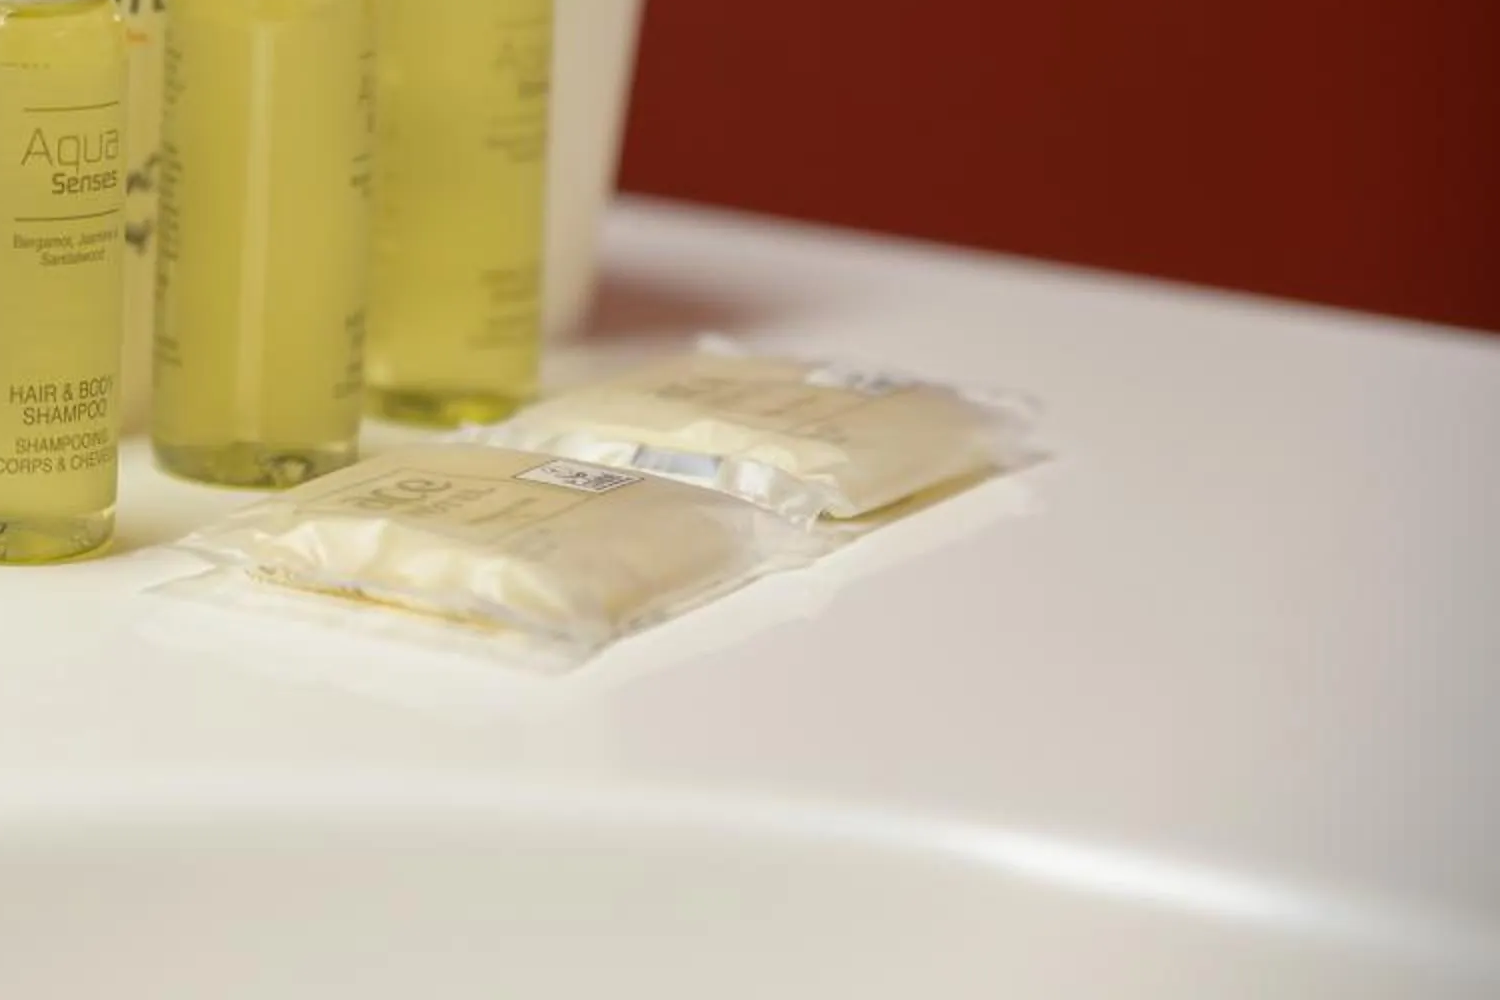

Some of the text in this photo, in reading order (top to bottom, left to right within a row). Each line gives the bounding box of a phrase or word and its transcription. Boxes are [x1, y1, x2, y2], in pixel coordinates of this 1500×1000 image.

[20, 126, 119, 175] Aqua
[51, 170, 117, 195] Senses
[8, 383, 57, 405] HAIR
[62, 381, 74, 402] &
[22, 398, 108, 426] SHAMPOO
[56, 456, 67, 474] &
